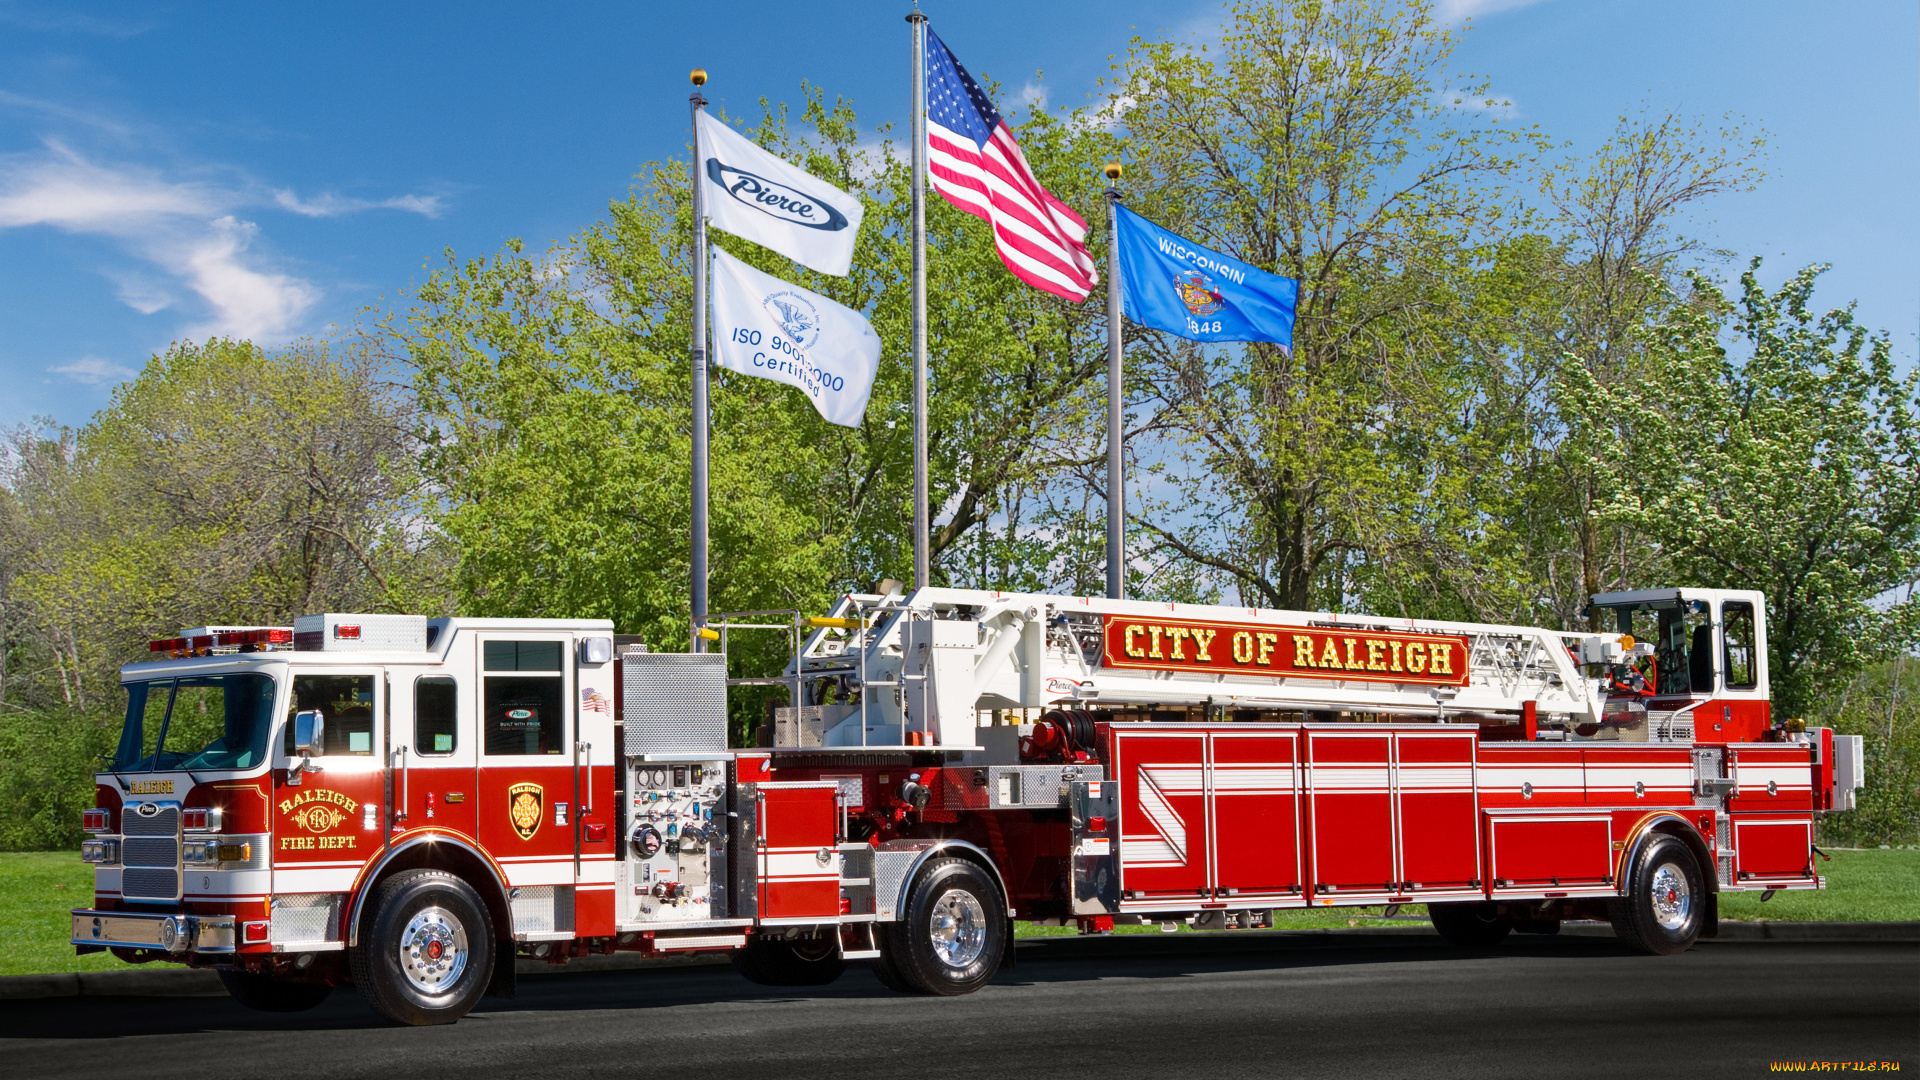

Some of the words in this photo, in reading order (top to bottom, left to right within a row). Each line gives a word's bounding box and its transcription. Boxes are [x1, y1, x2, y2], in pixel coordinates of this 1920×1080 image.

[731, 175, 814, 218] Pierce
[1158, 236, 1246, 286] WISCONSIN
[1186, 316, 1222, 334] 1848
[732, 327, 762, 346] ISO
[753, 352, 820, 398] Certified
[1124, 624, 1217, 662] CITY
[1232, 630, 1278, 666] OF
[1293, 634, 1454, 675] RALEIGH
[1048, 679, 1072, 690] Pierce
[130, 780, 175, 795] RALEIGH
[511, 786, 541, 796] RALEIGH
[279, 788, 359, 815] RALEIGH
[280, 836, 316, 851] FIRE
[318, 836, 357, 850] DEPT.
